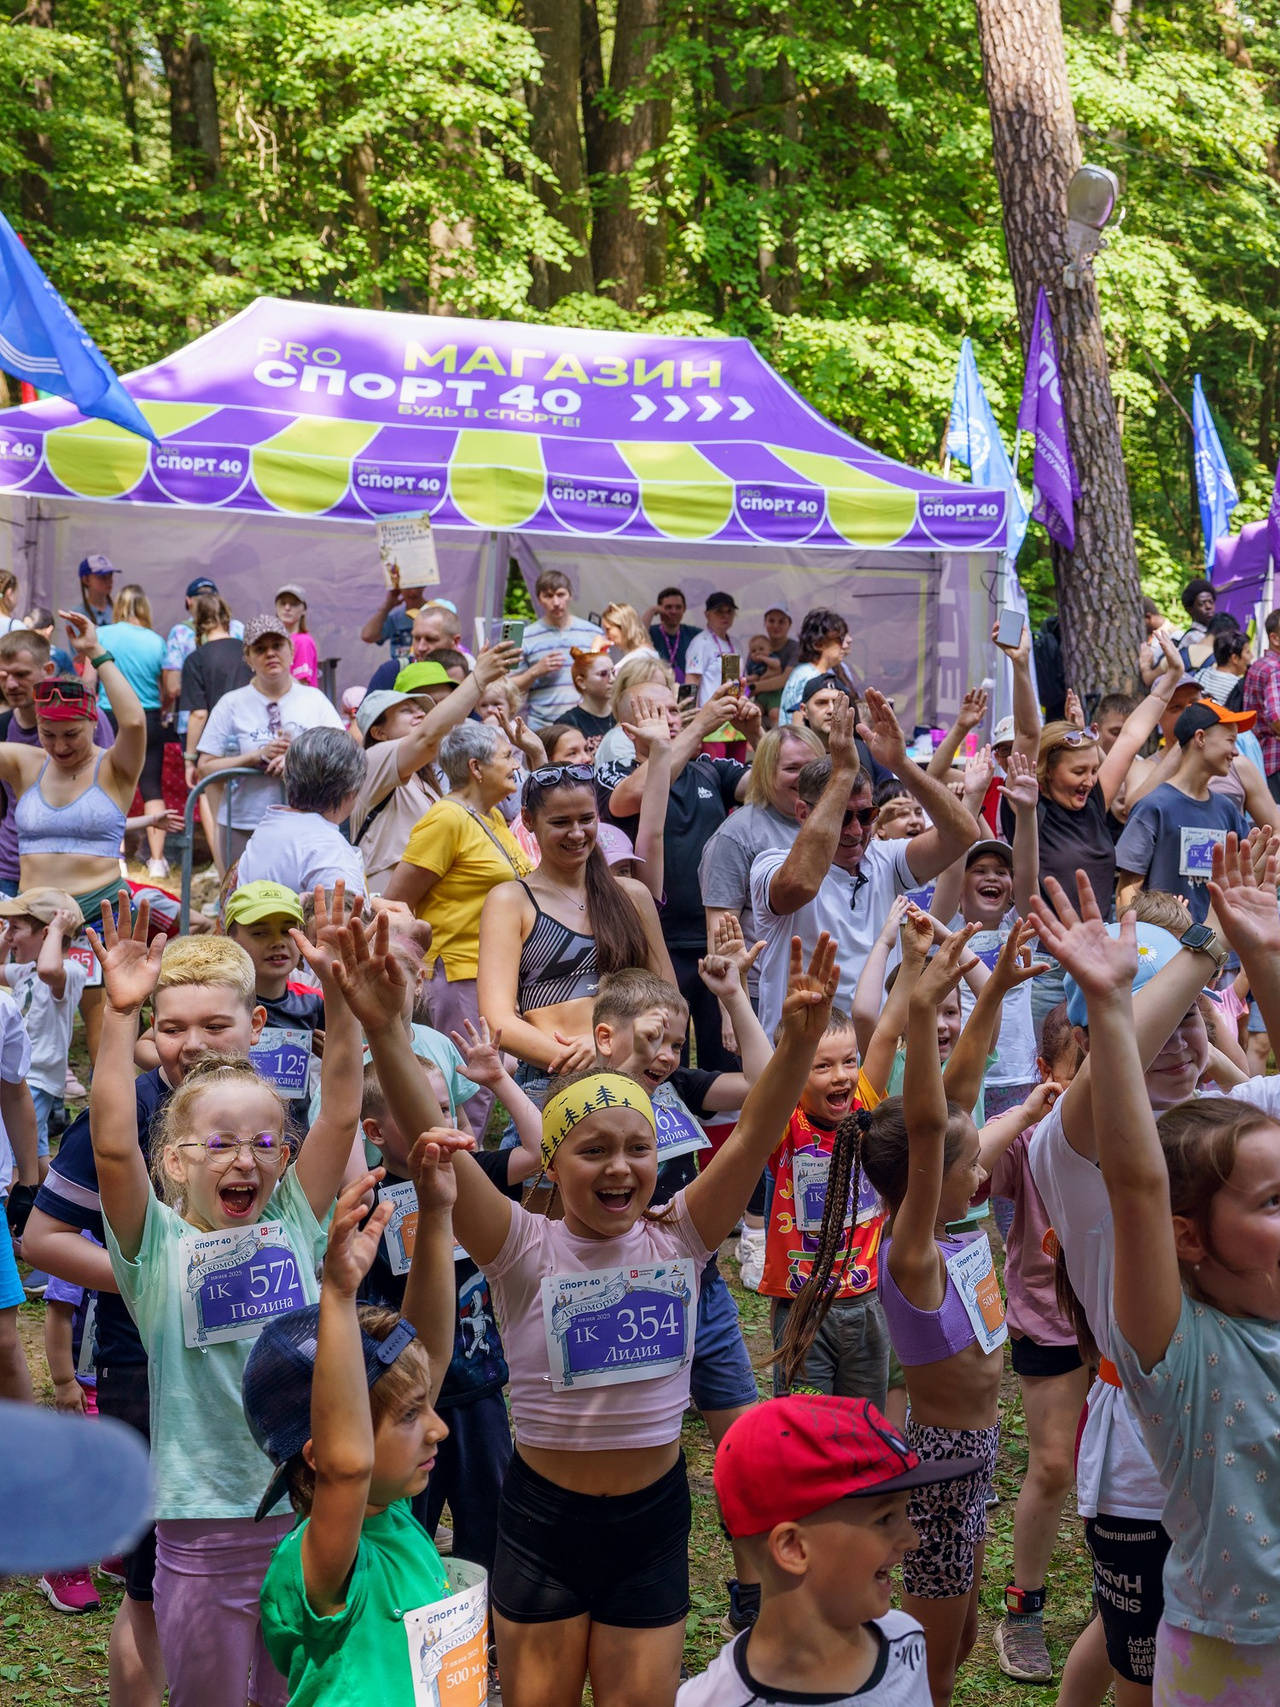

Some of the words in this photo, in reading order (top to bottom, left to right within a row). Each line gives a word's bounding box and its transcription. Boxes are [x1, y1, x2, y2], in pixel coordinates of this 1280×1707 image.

[256, 337, 341, 366] PRO
[403, 340, 722, 388] МАГАЗИН
[253, 360, 486, 407] СПОРТ
[499, 384, 582, 415] 40
[398, 404, 459, 418] БУДЬ
[464, 406, 479, 418] В
[484, 408, 580, 428] СПОРТЕ!
[11, 442, 36, 457] 40
[156, 455, 217, 473] СПОРТ
[219, 459, 242, 474] 40
[357, 474, 416, 491] СПОРТ
[418, 477, 440, 492] 40
[552, 487, 608, 503] СПОРТ
[610, 491, 631, 505] 40
[740, 497, 798, 512] СПОРТ
[800, 500, 818, 513] 40
[923, 504, 976, 516] СПОРТ
[978, 504, 998, 516] 40
[274, 1053, 307, 1076] 125
[391, 1187, 414, 1198] СПОРТ
[809, 1191, 825, 1203] 1К
[194, 1240, 220, 1250] СПОРТ
[221, 1237, 232, 1245] 40
[194, 1249, 252, 1279] Лукоморье
[956, 1254, 973, 1269] СПОРТ
[206, 1282, 232, 1301] 1К
[249, 1258, 299, 1298] 572
[560, 1280, 589, 1290] СПОРТ
[230, 1296, 294, 1319] Полина
[561, 1292, 620, 1321] Лукоморье
[574, 1326, 600, 1344] 1К
[617, 1303, 680, 1343] 354
[597, 1313, 611, 1321] 2025
[604, 1344, 662, 1363] Лидия
[427, 1606, 458, 1624] СПОРТ
[459, 1602, 470, 1611] 40
[446, 1667, 469, 1689] 500
[471, 1663, 480, 1675] м
